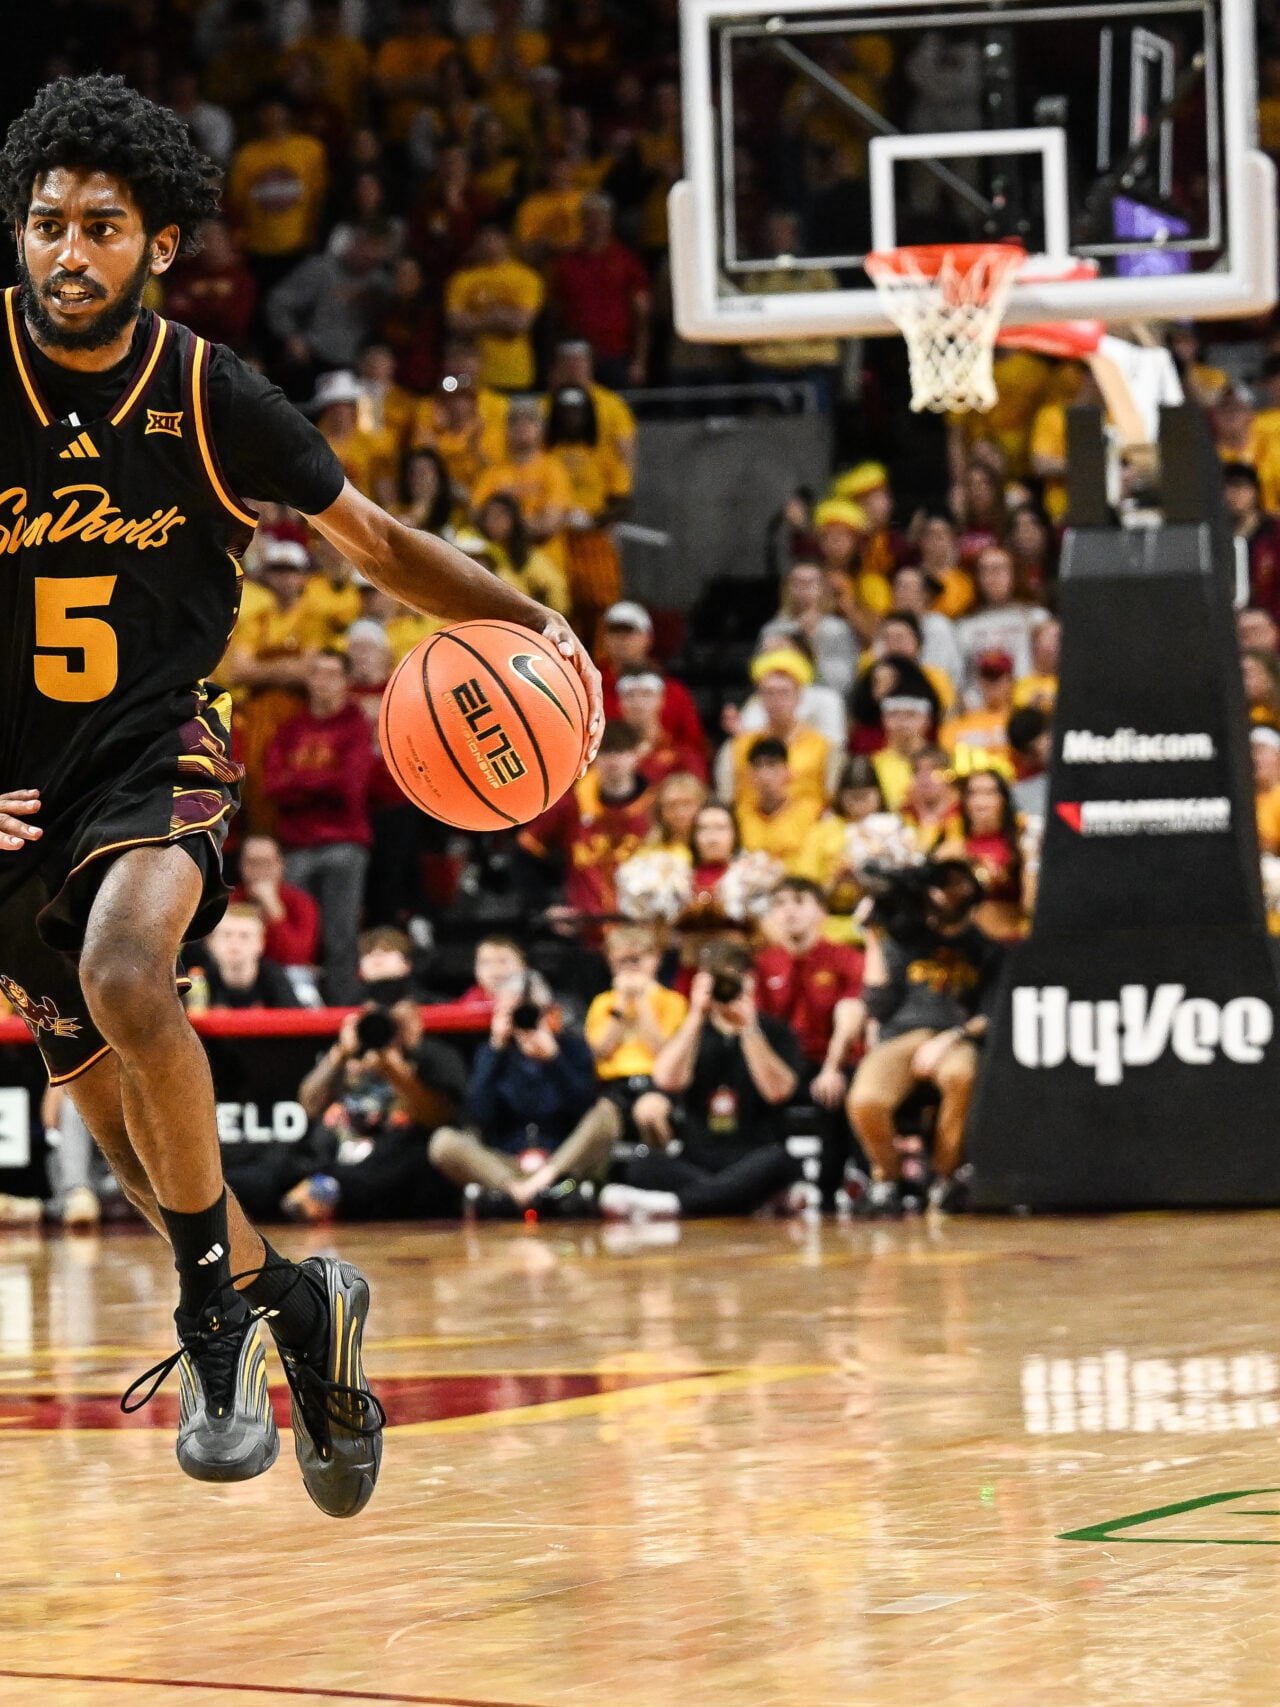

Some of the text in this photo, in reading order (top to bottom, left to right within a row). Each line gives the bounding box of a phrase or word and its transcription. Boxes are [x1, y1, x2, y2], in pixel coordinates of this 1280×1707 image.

[33, 574, 118, 702] 5
[451, 677, 528, 786] ELITE
[1062, 728, 1213, 763] Mediacom
[216, 1101, 308, 1143] ELD
